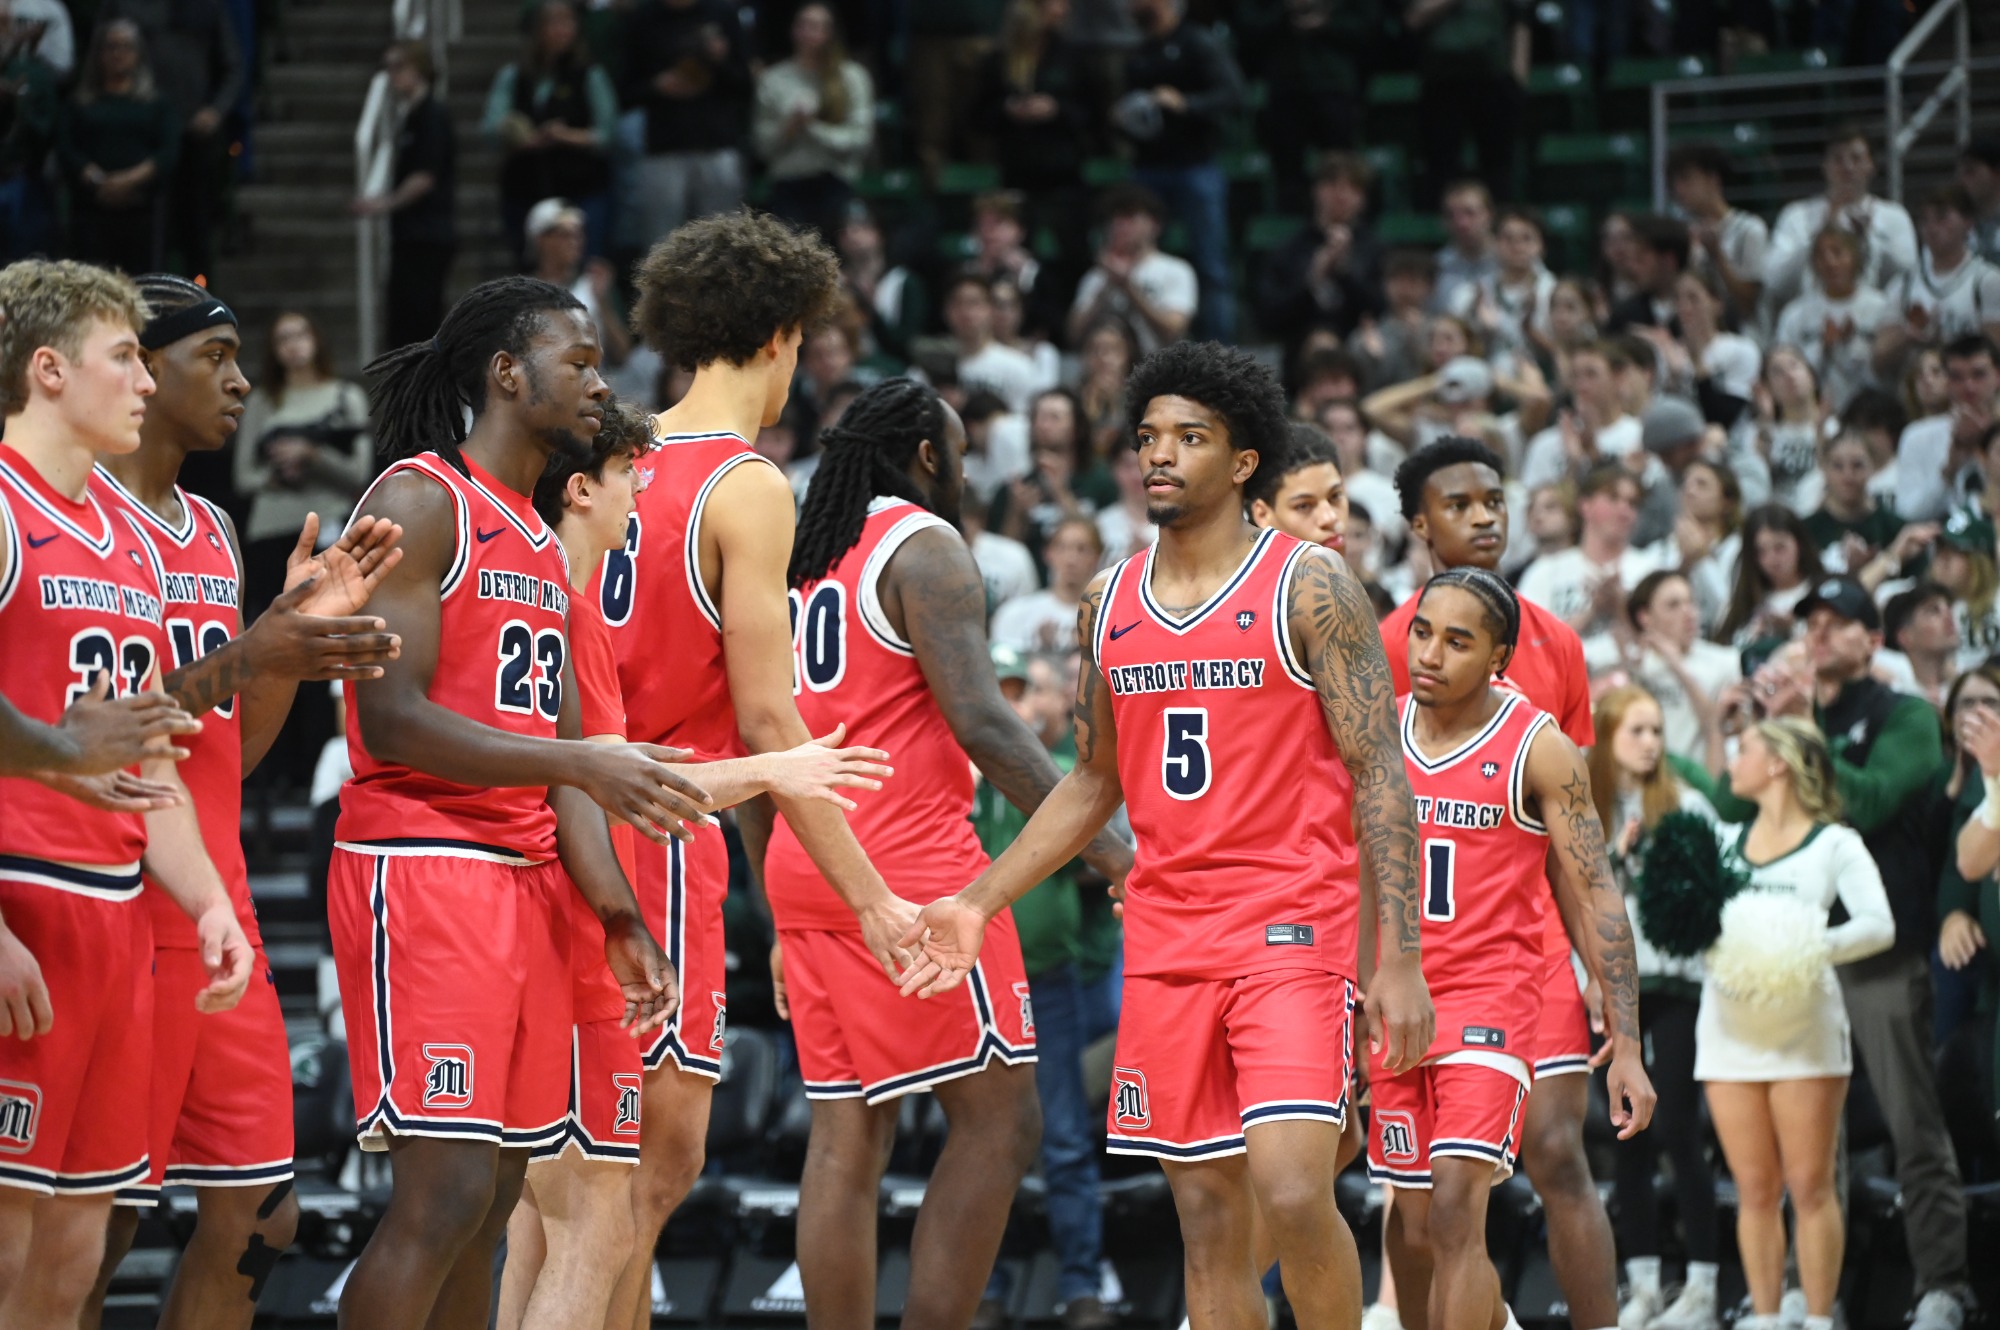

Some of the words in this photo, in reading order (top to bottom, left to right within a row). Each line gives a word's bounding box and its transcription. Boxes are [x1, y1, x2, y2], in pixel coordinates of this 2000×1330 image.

[39, 575, 120, 614] DETROIT
[165, 573, 198, 603] ROIT
[200, 574, 238, 610] MERC
[479, 569, 539, 606] DETROIT
[788, 579, 847, 696] 0
[495, 619, 565, 722] 23
[1109, 661, 1187, 695] DETROIT
[1191, 658, 1265, 690] MERCY
[1162, 707, 1212, 801] 5
[1434, 797, 1505, 830] MERCY
[1424, 838, 1455, 922] 1
